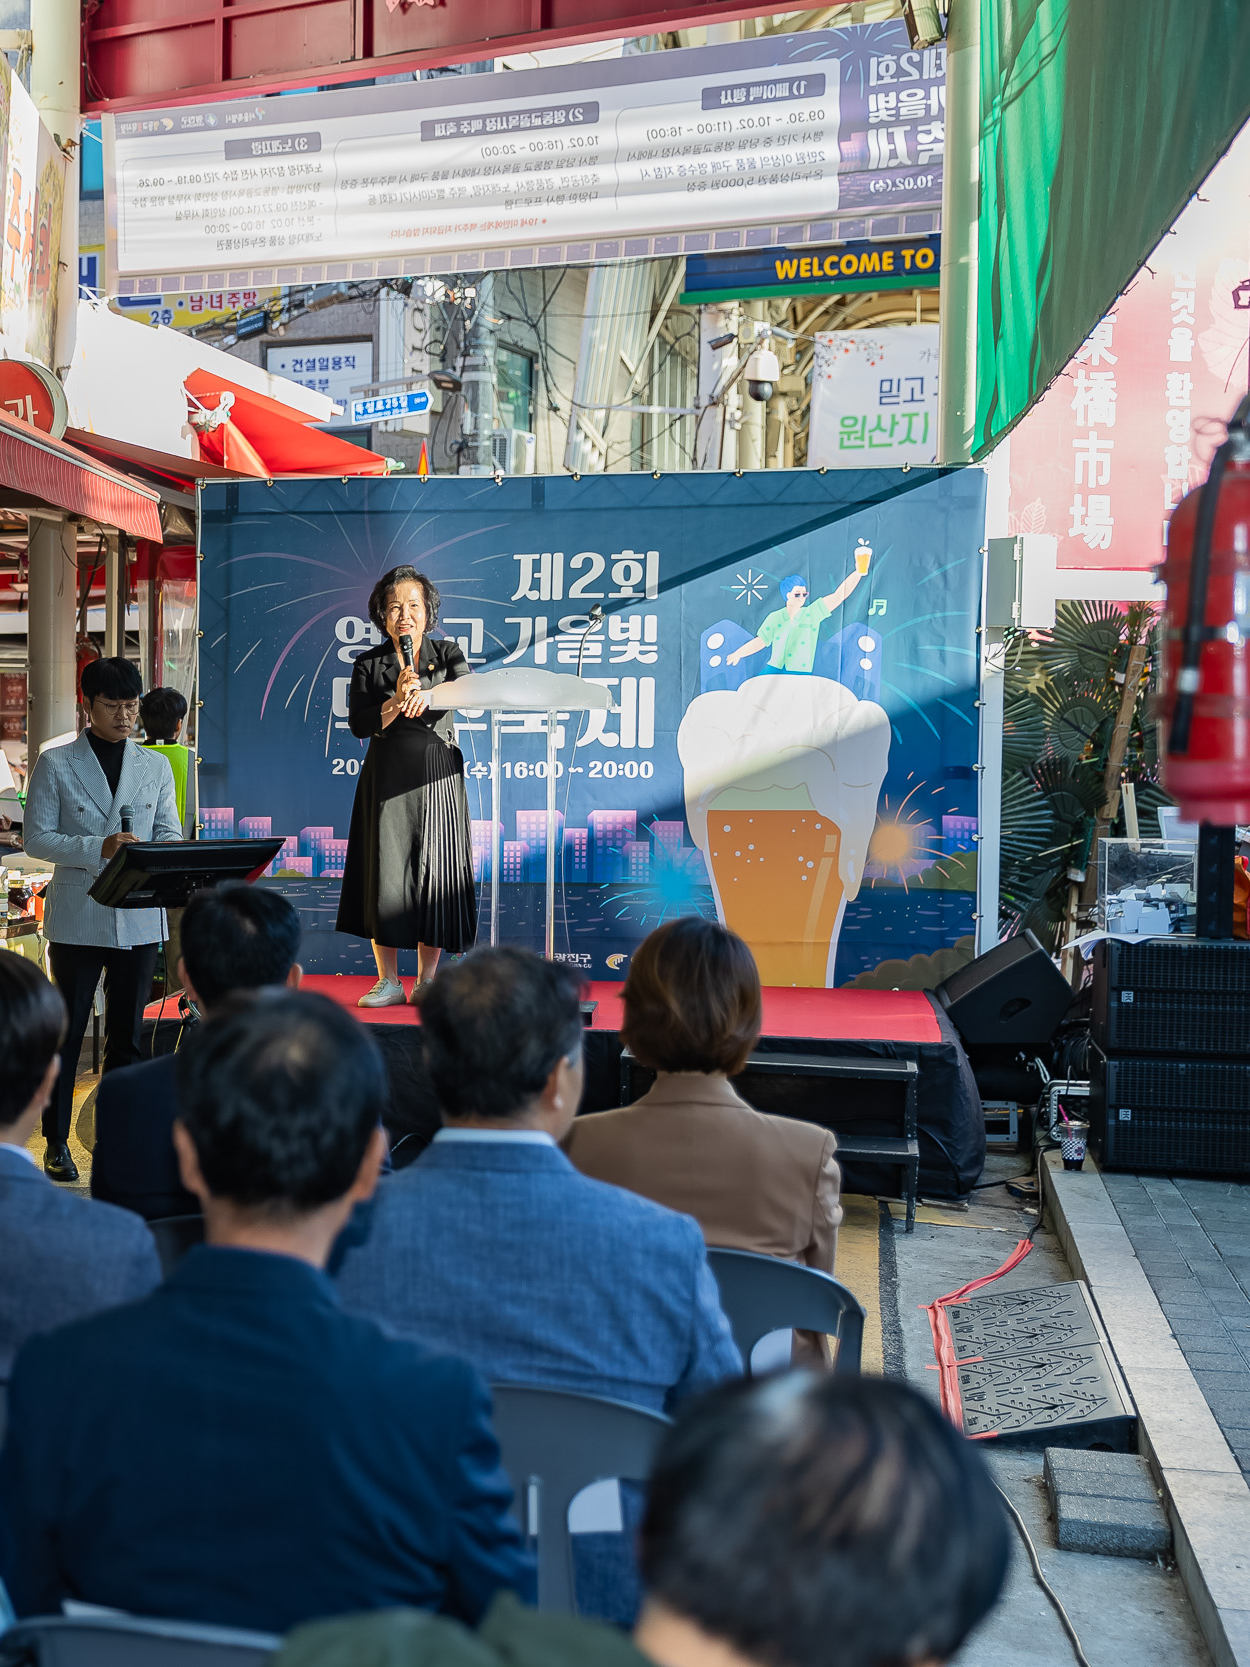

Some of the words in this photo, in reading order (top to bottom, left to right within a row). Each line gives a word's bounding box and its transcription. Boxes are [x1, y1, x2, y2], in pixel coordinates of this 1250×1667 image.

[775, 251, 894, 280] WELCOME
[901, 248, 935, 269] TO
[151, 309, 173, 325] 2층
[292, 355, 356, 373] 건설일용직
[879, 377, 926, 406] 믿고
[839, 412, 929, 450] 원산지
[1163, 372, 1193, 546] 환영합니
[511, 550, 660, 601] 제2회
[334, 615, 487, 665] 영교
[502, 615, 659, 666] 가을빛
[503, 761, 564, 778] 16:00
[588, 761, 654, 778] 20:00
[554, 952, 592, 964] 광진구
